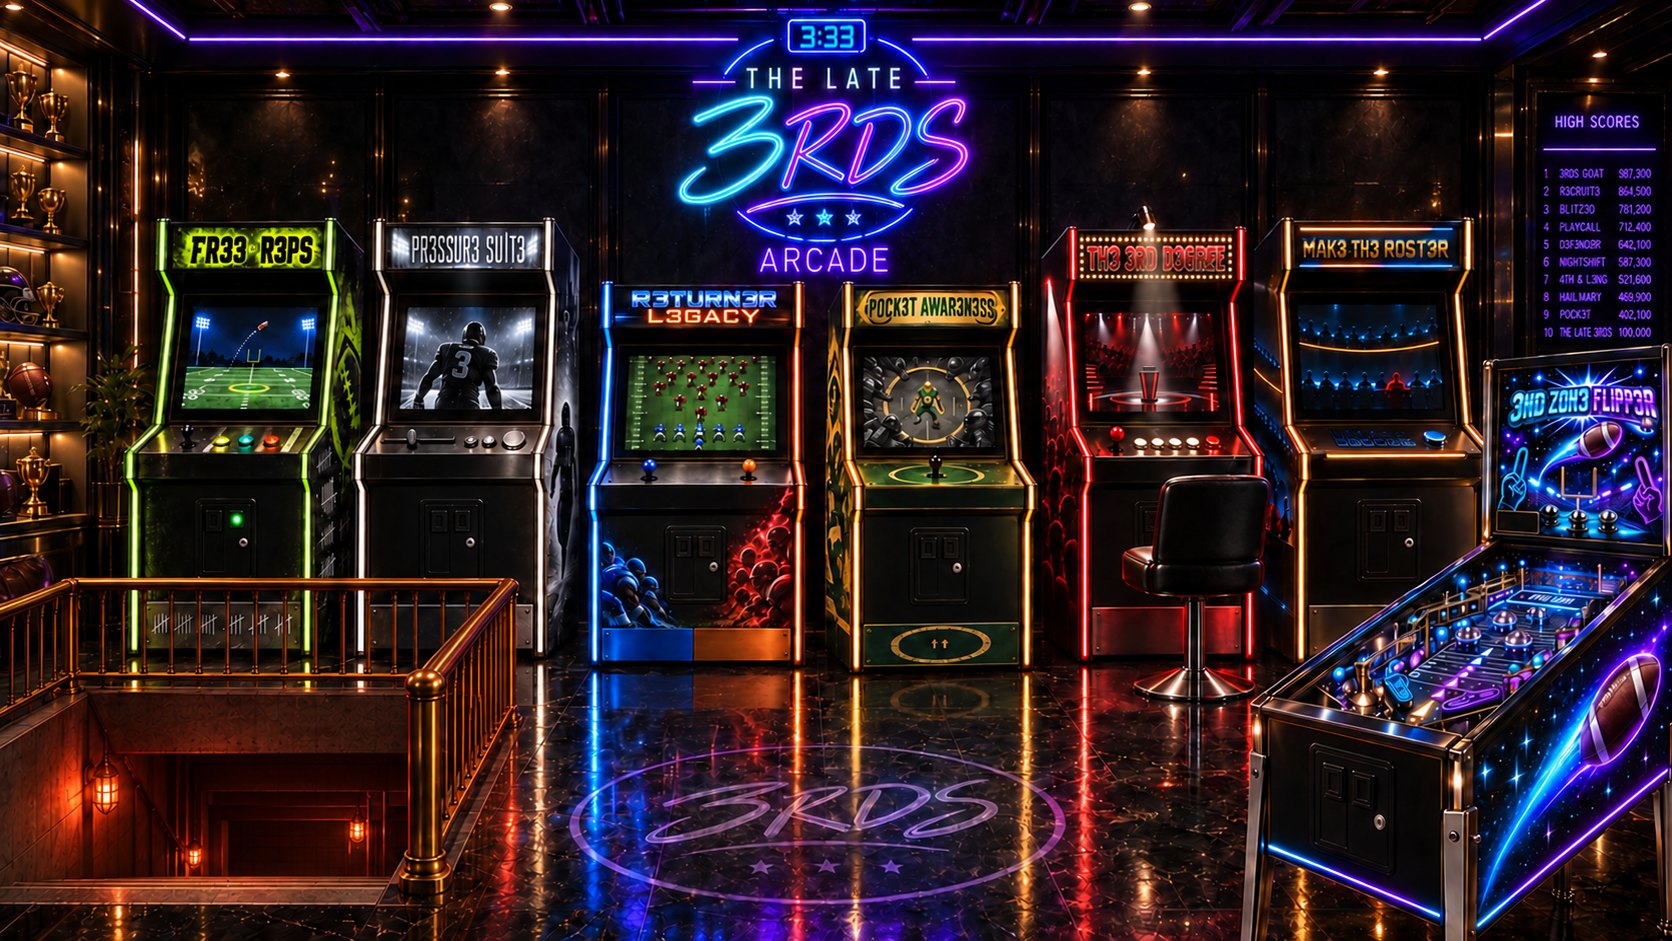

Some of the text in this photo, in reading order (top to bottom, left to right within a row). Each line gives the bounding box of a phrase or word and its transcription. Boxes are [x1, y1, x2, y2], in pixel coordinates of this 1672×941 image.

[800, 25, 855, 49] 3:33
[746, 67, 901, 89] THE LATE
[1554, 114, 1640, 129] HIGH SCORES
[678, 95, 970, 205] 3RDS
[1544, 168, 1548, 178] 1
[1582, 168, 1604, 178] GOAT
[1543, 186, 1652, 197] 2 R3CRUIT3 864,500
[1543, 204, 1549, 214] 3
[1618, 204, 1652, 215] 781,200
[1543, 222, 1549, 232] 4
[1559, 222, 1600, 232] PLAYCALL
[190, 235, 314, 264] FR33 R3PS
[411, 235, 480, 263] PR3SSUR3
[1303, 238, 1449, 259] MAK3 TH3 ROST3R
[1543, 240, 1549, 250] 5
[1618, 240, 1652, 251] 642,100
[759, 247, 889, 273] ARCADE
[1087, 245, 1121, 272] TH3
[1124, 245, 1157, 272] 3RD
[1543, 257, 1549, 267] 6
[1559, 257, 1606, 267] NIGHTSHIFT
[1543, 275, 1549, 285] 7
[1559, 275, 1575, 285] 4TH
[631, 290, 777, 308] R3TURN3R
[1543, 292, 1549, 302] 8
[648, 309, 760, 324] L3GACY
[869, 297, 996, 318] POCK3T AWAR3N3SS
[1543, 310, 1652, 321] 9 POCK3T 402,100
[1544, 328, 1553, 338] 10
[1560, 328, 1571, 338] THE
[1574, 328, 1592, 338] LATE
[1618, 328, 1652, 339] 100,000
[451, 350, 472, 379] 3
[1593, 388, 1658, 419] FLIPP3R
[645, 778, 999, 844] 3RDS
